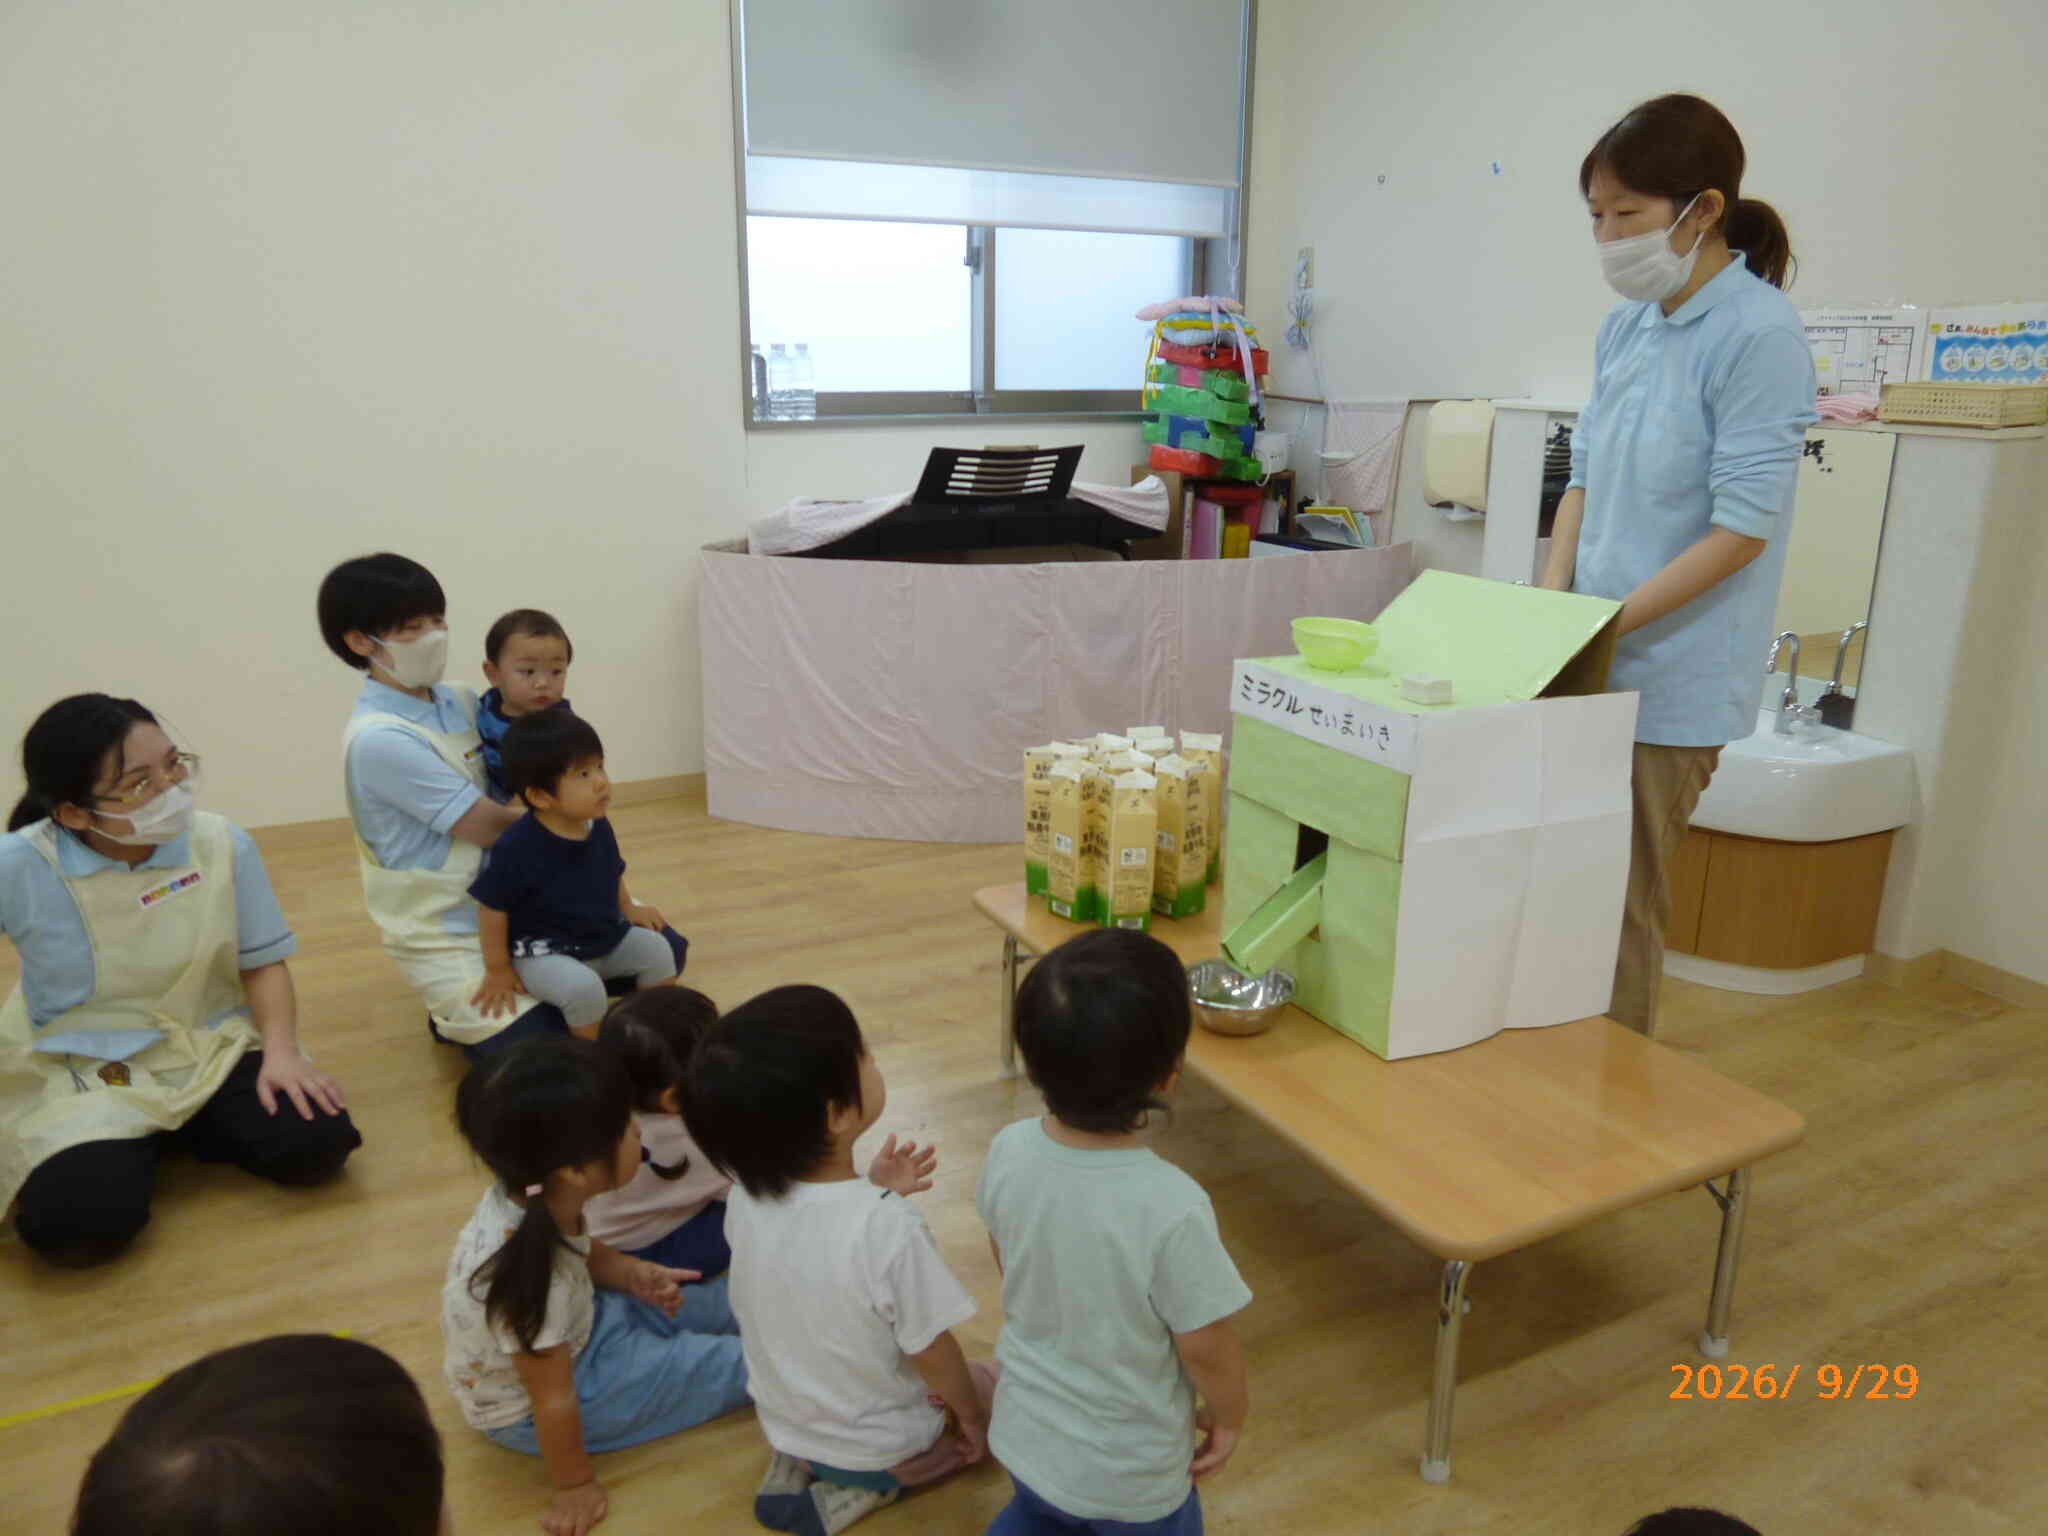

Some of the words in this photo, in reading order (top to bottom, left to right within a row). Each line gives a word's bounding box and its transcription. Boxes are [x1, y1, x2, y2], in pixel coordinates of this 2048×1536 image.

[1241, 674, 1390, 751] ミラクルせいまいき
